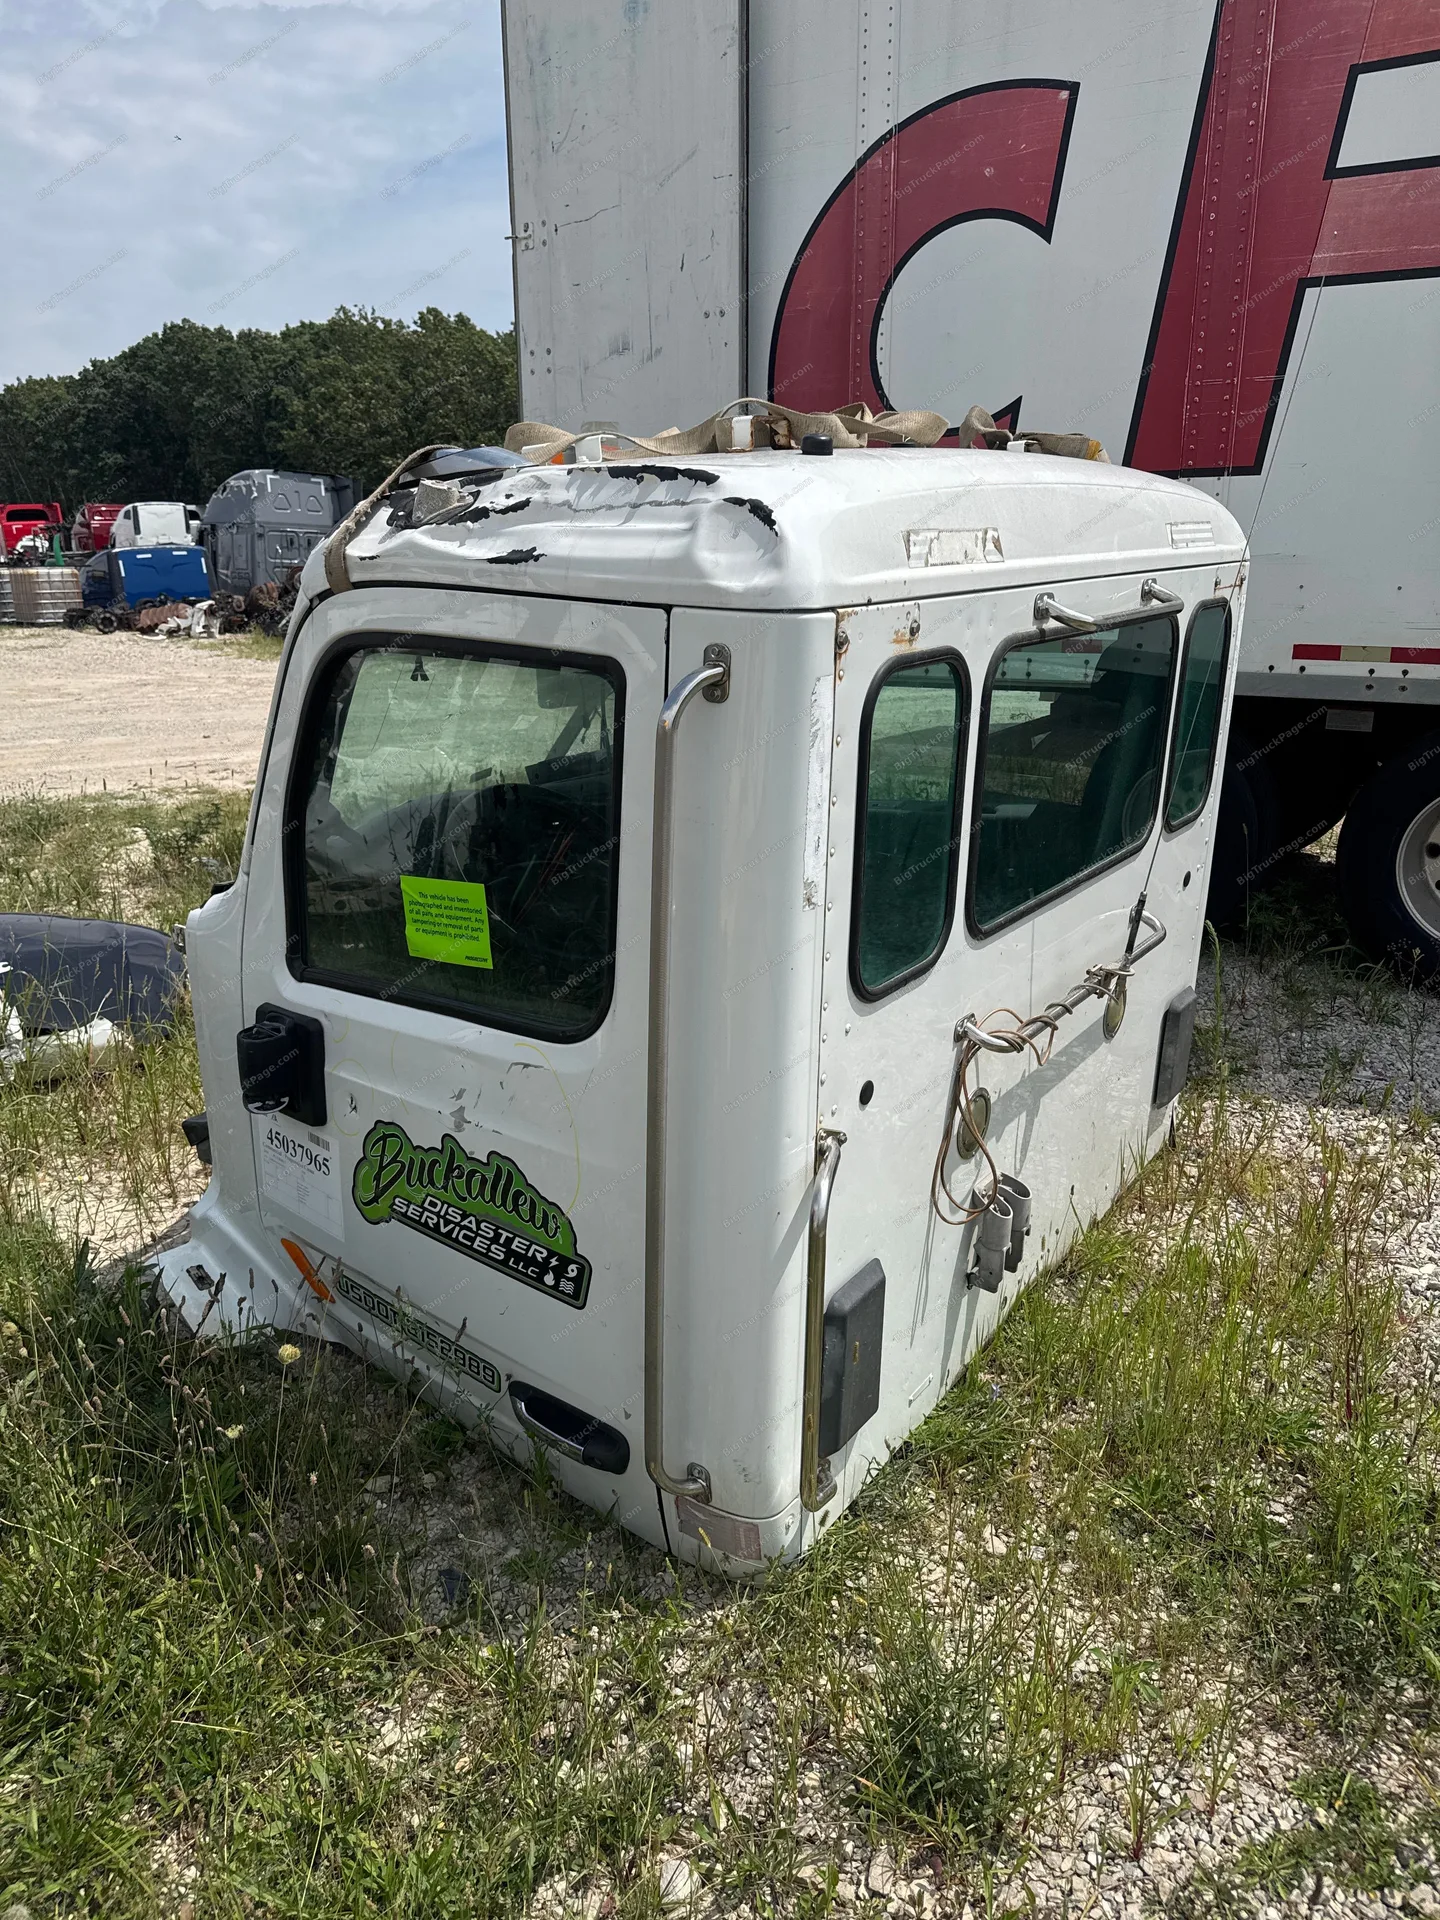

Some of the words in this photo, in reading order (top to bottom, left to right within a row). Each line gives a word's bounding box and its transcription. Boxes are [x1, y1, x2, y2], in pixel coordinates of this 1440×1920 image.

[408, 900, 442, 910] photographed
[454, 905, 482, 914] inventoried
[429, 893, 446, 901] vehicle
[456, 896, 470, 904] been
[412, 917, 436, 928] tampering
[442, 922, 463, 930] removal
[470, 926, 484, 934] parts
[422, 910, 434, 918] parts
[474, 916, 484, 925] Any
[422, 928, 448, 937] equipment
[266, 1128, 331, 1176] 45037965
[359, 1130, 562, 1241] Buckallew
[392, 1196, 507, 1261] SERVICES
[508, 1257, 540, 1278] LLC
[422, 1196, 548, 1262] DISASTER
